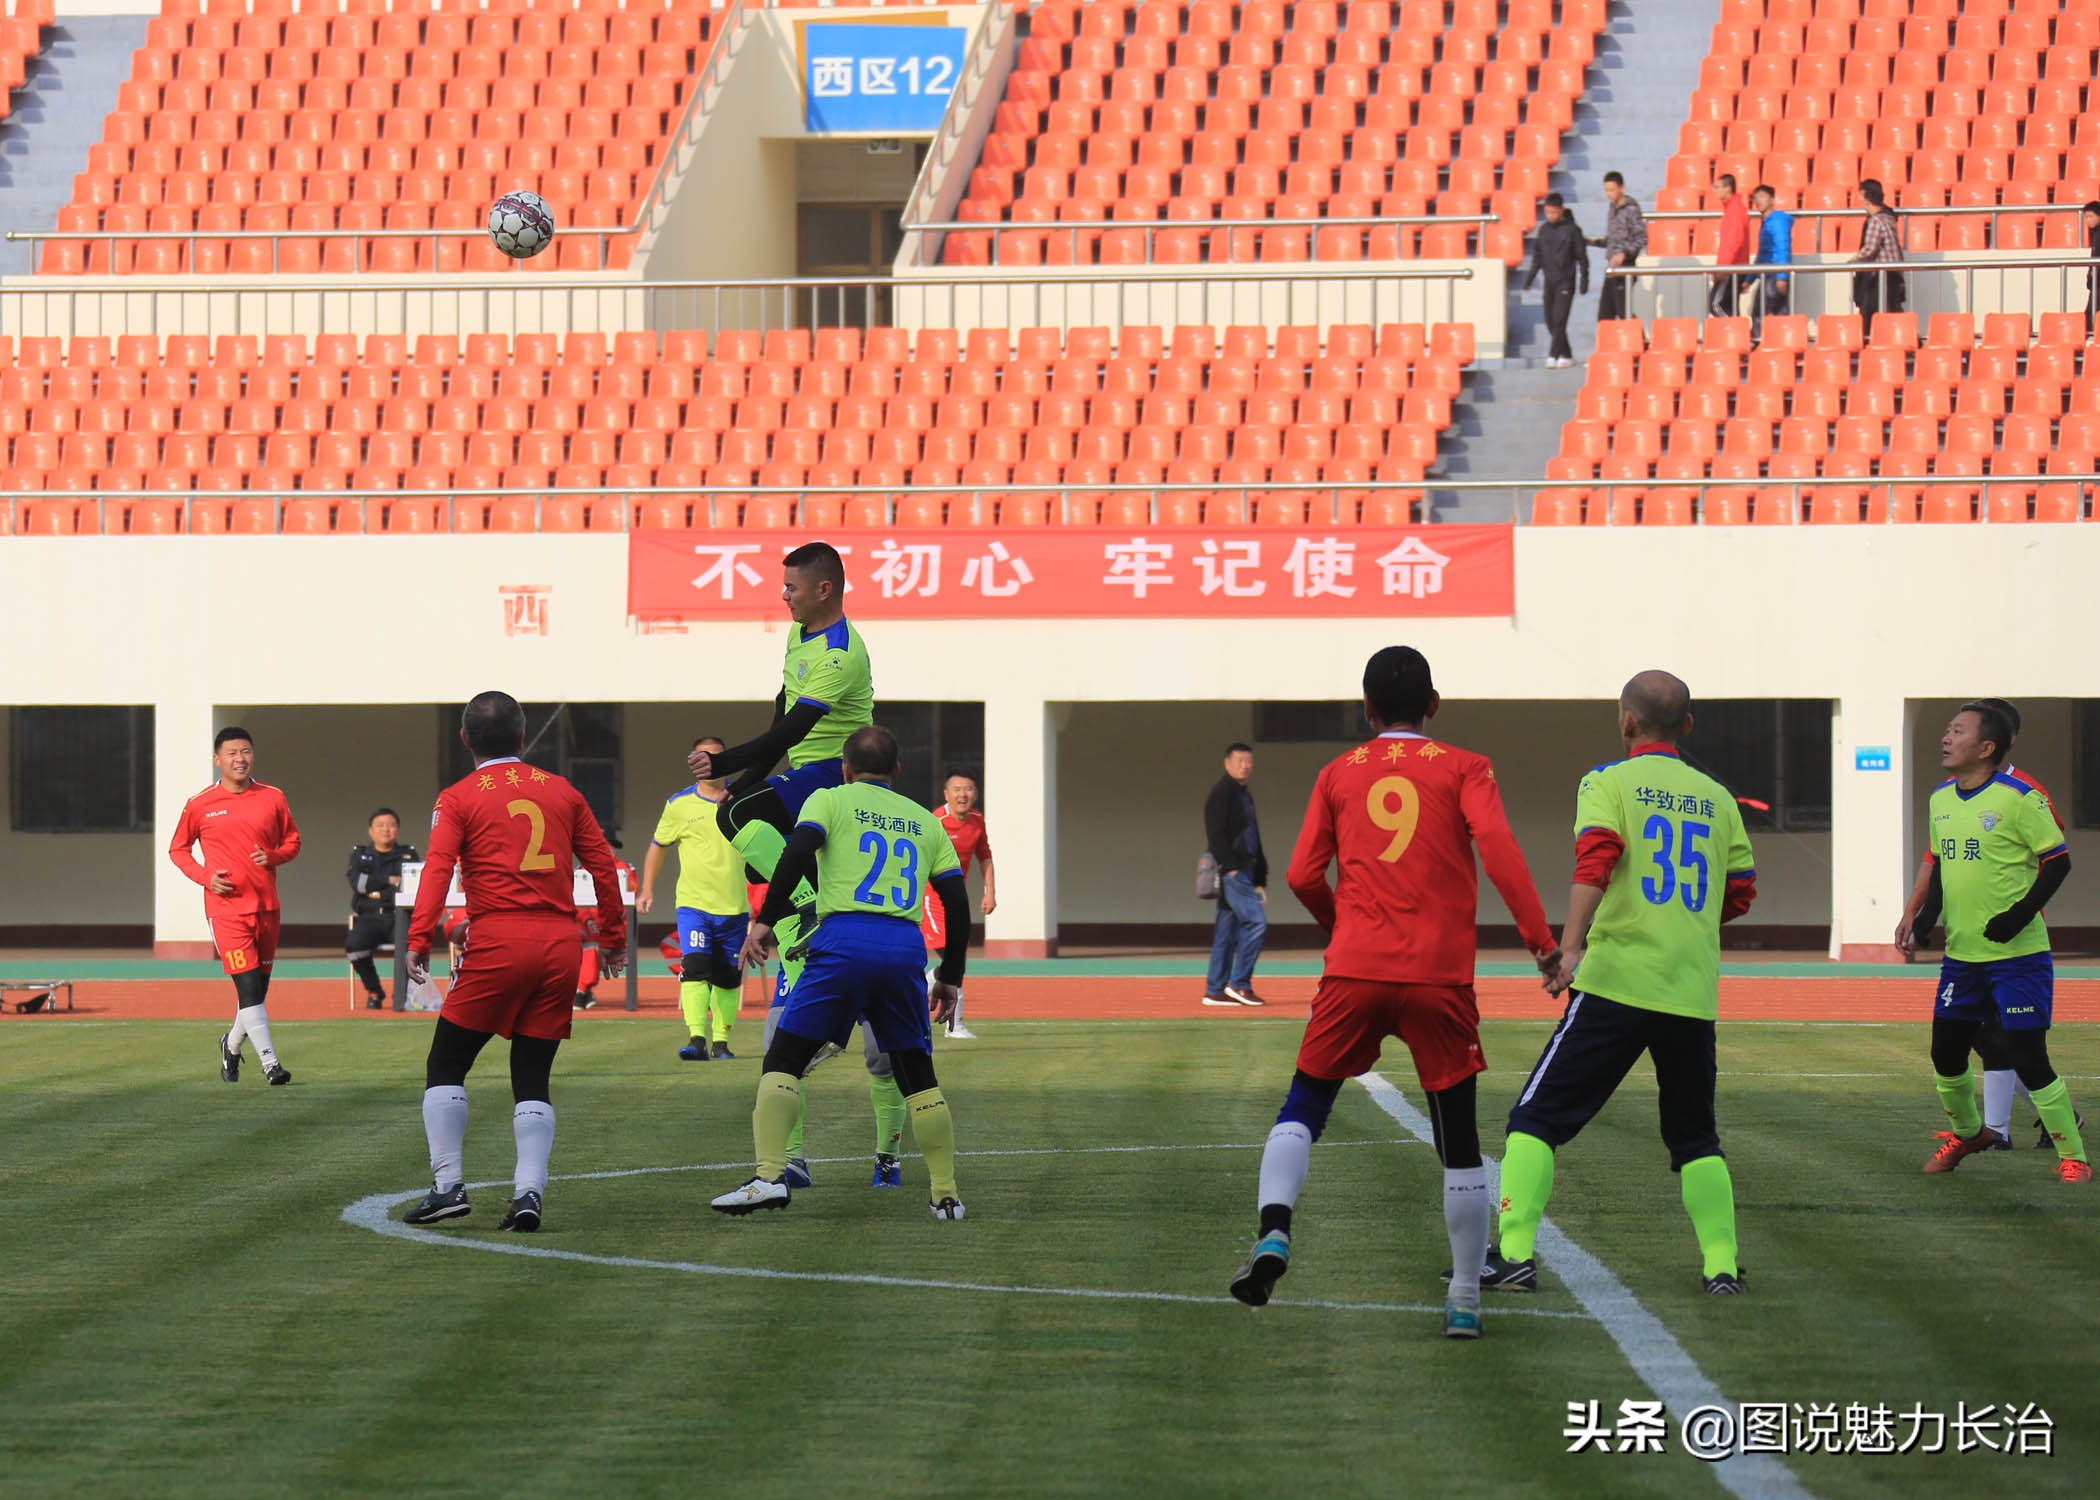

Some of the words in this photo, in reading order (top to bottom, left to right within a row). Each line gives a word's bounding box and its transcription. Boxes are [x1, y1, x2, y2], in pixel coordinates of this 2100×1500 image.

[811, 55, 953, 97] 西区12
[690, 538, 1036, 599] 不初心
[1101, 536, 1452, 599] 牢记使命
[1346, 741, 1447, 767] 老革命
[476, 767, 550, 792] 老革命
[1635, 786, 1716, 819] 华致酒库
[853, 808, 923, 836] 华致酒库
[1366, 775, 1420, 864] 9
[506, 798, 556, 872] 2
[853, 830, 919, 911] 23
[1641, 813, 1710, 913] 35
[689, 929, 706, 948] 99
[225, 948, 247, 971] 18
[1940, 982, 1955, 1007] 4
[2006, 1006, 2035, 1014] KELME
